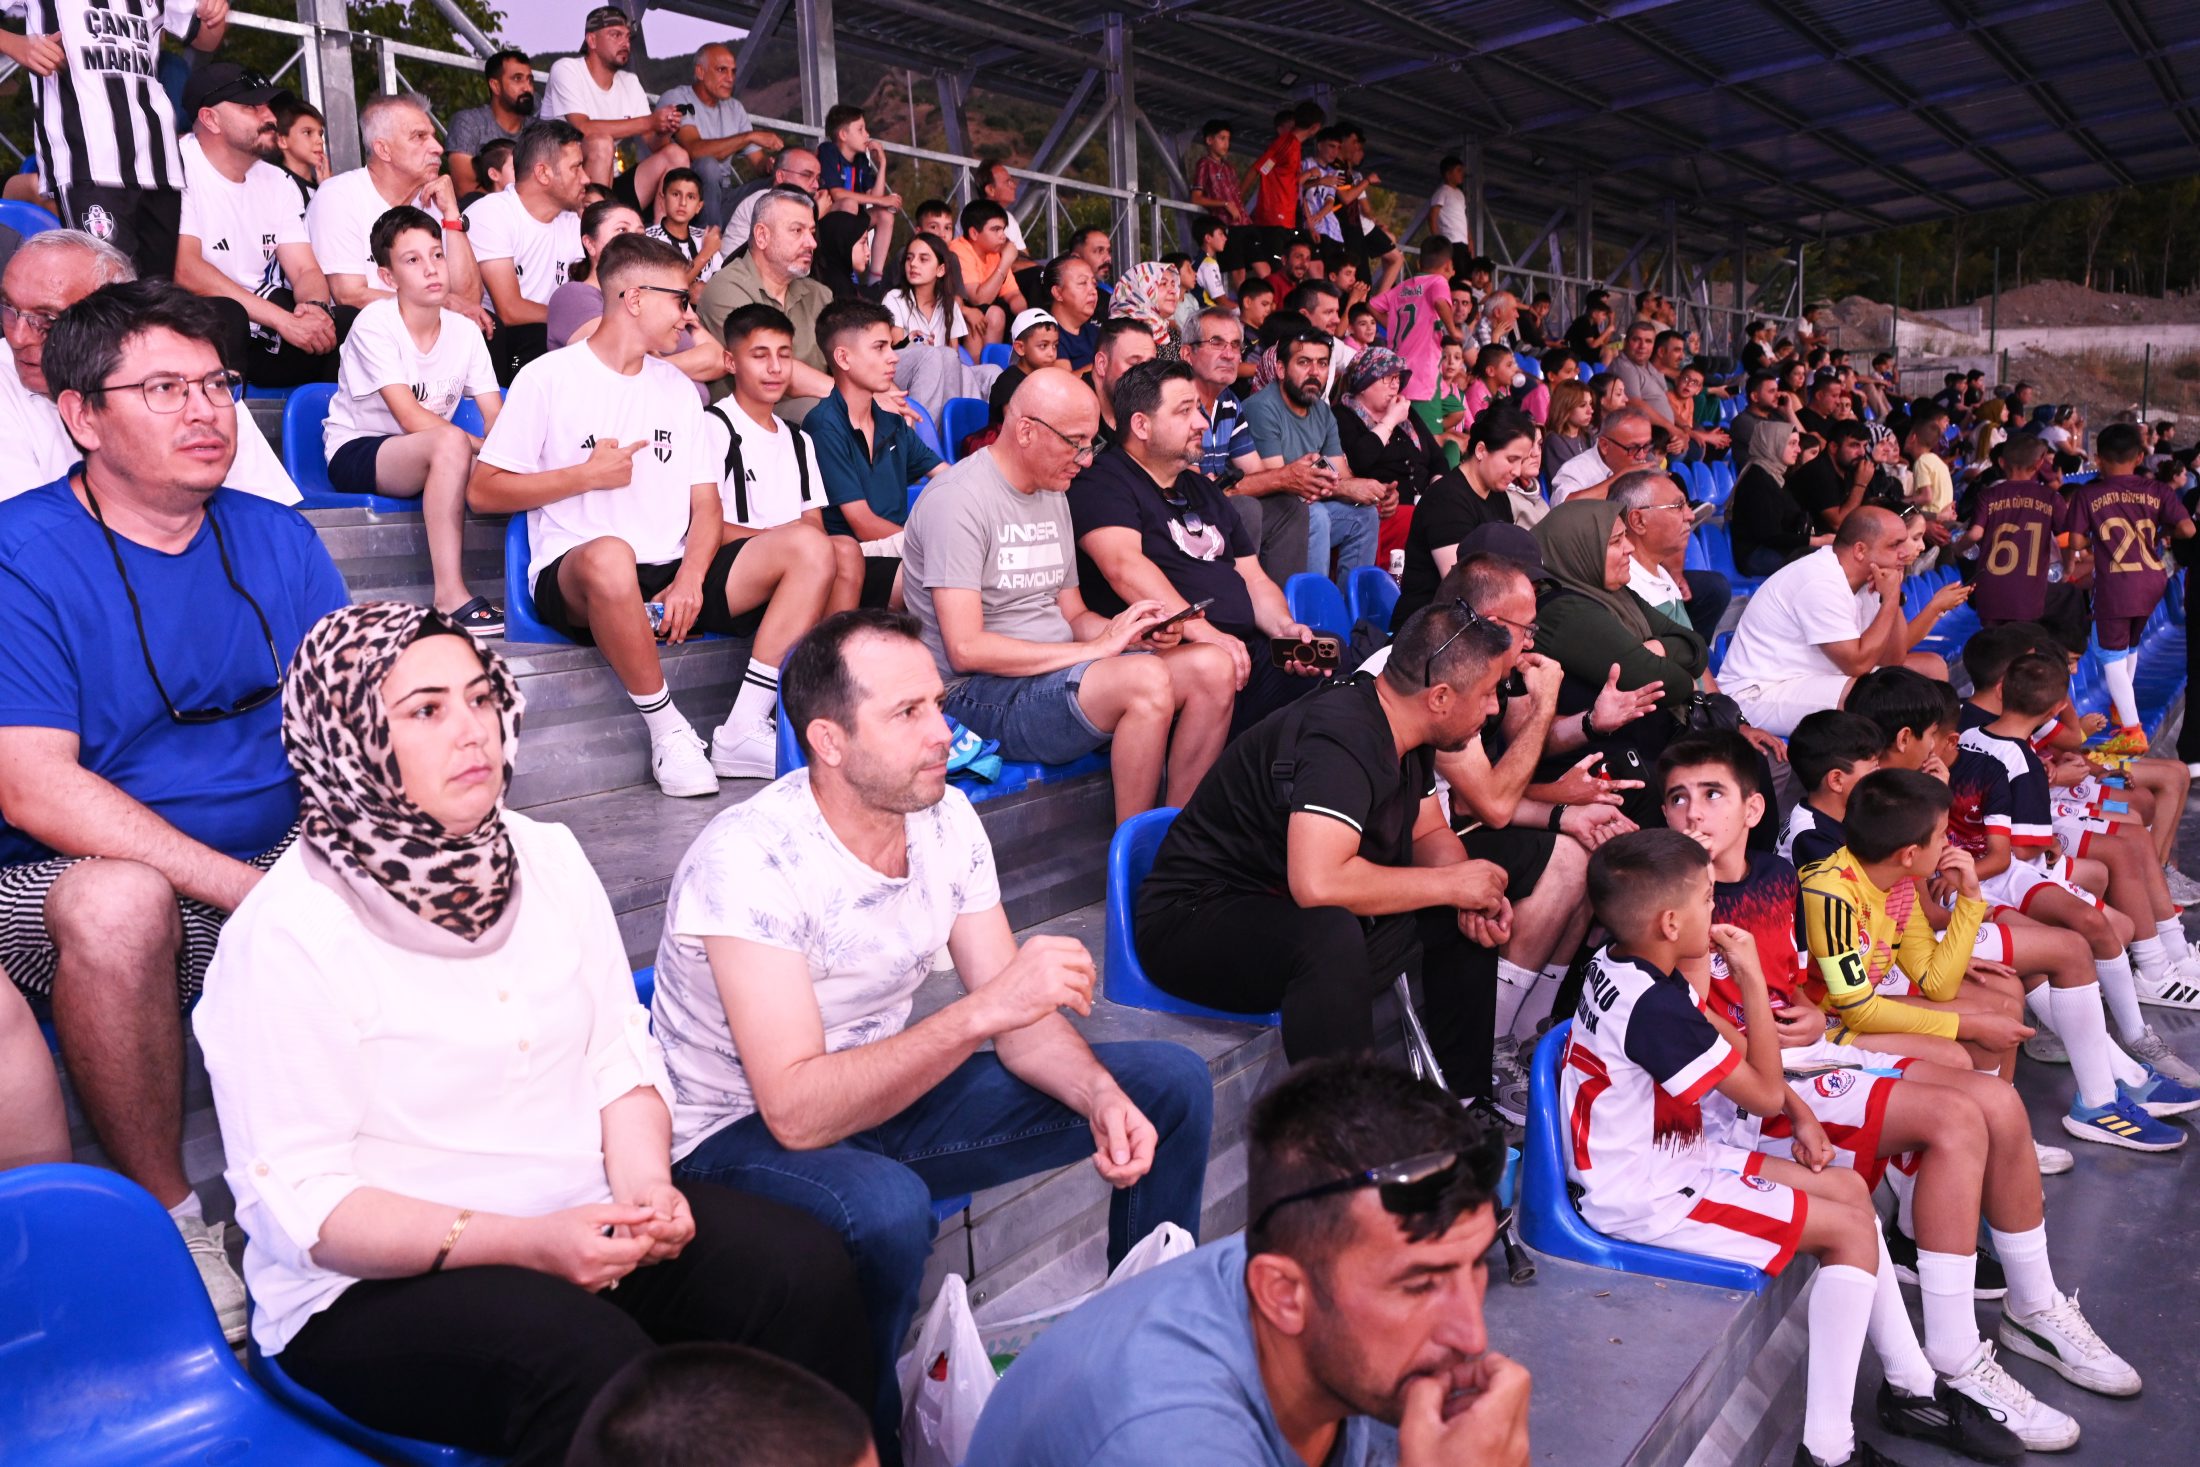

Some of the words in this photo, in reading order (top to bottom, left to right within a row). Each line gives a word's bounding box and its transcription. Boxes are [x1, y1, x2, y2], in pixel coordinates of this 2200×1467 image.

[83, 9, 149, 43] ÇANTA
[2035, 500, 2053, 517] SPOR
[997, 520, 1059, 543] UNDER
[2100, 517, 2166, 573] 20
[1986, 522, 2043, 577] 61
[997, 568, 1064, 589] ARMOUR
[1839, 952, 1866, 986] C
